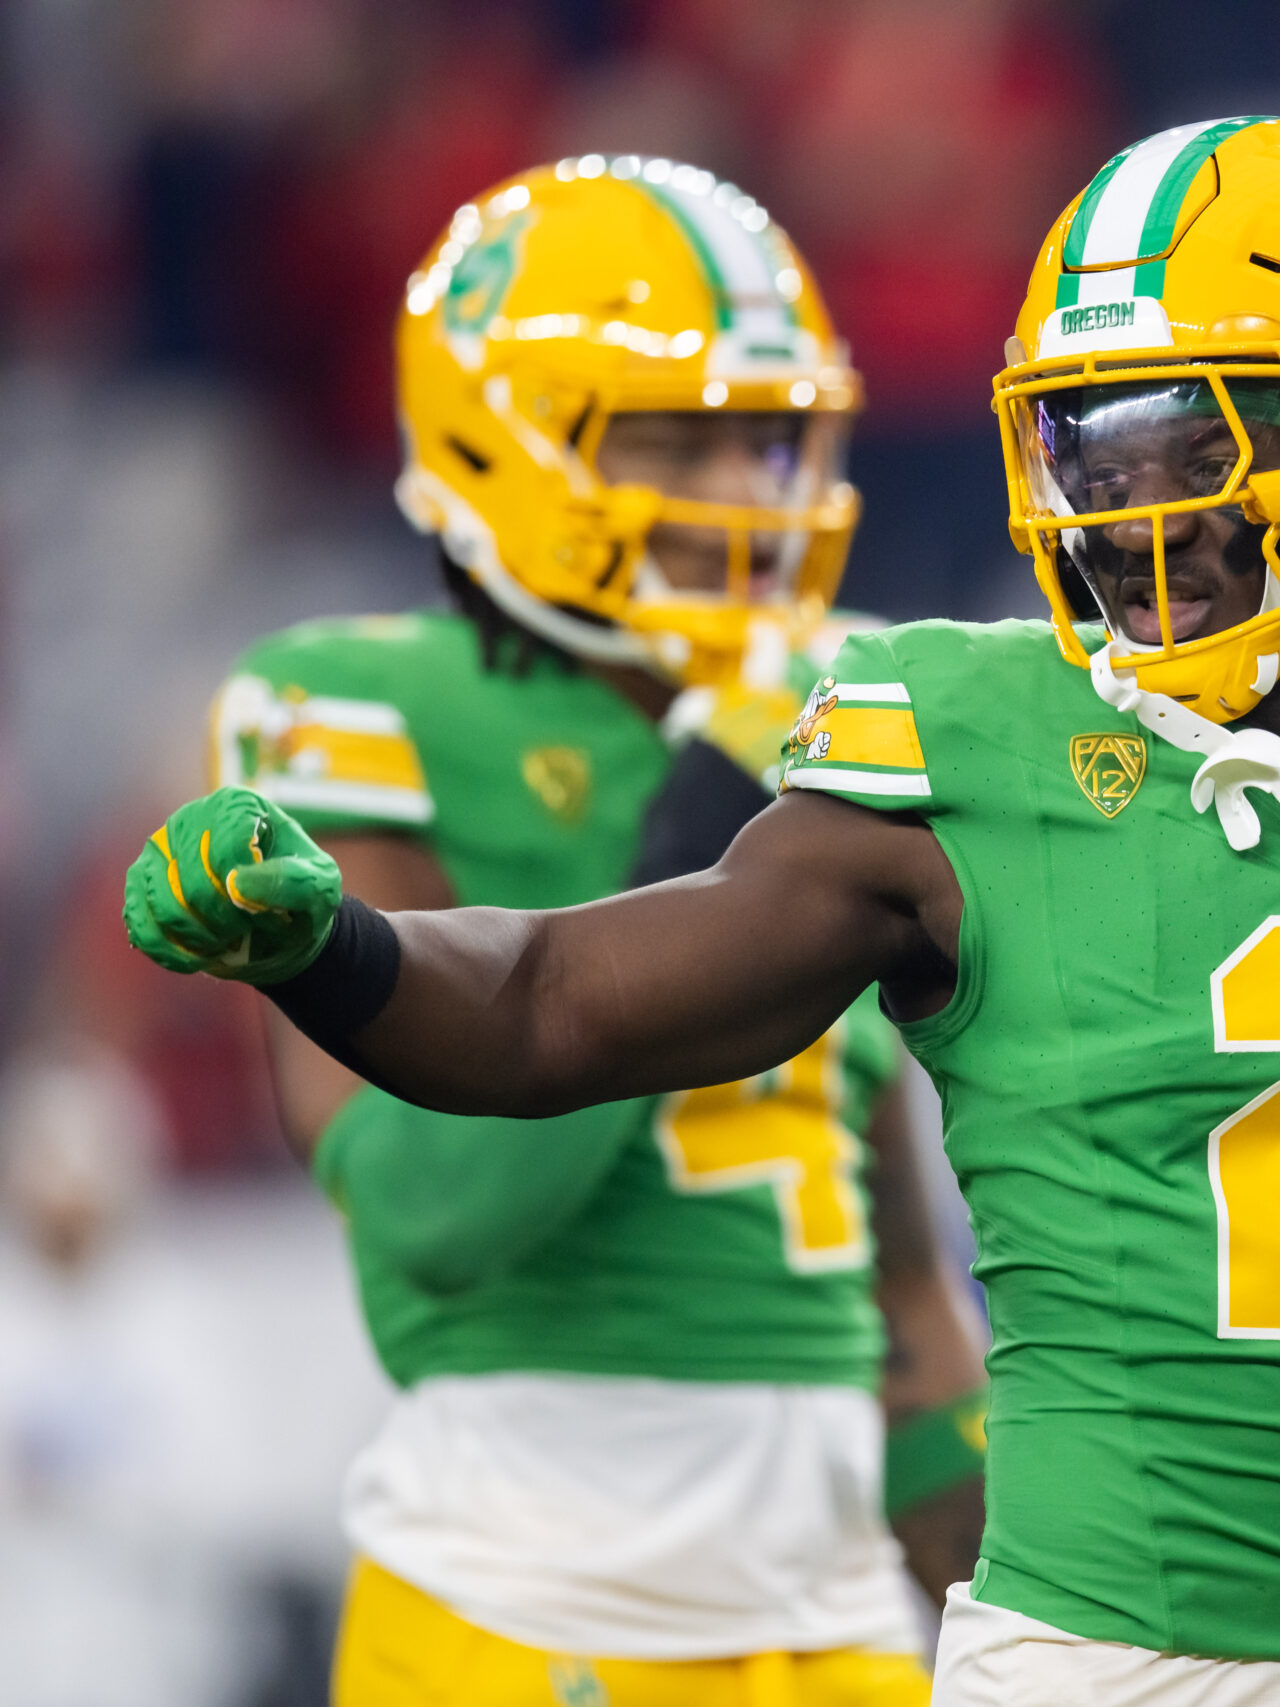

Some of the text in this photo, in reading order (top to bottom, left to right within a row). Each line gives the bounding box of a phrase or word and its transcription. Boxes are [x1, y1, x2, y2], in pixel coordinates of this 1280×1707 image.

[1060, 301, 1136, 336] OREGON
[1074, 736, 1142, 783] PAC
[1092, 770, 1127, 798] 12
[653, 1012, 874, 1274] 4
